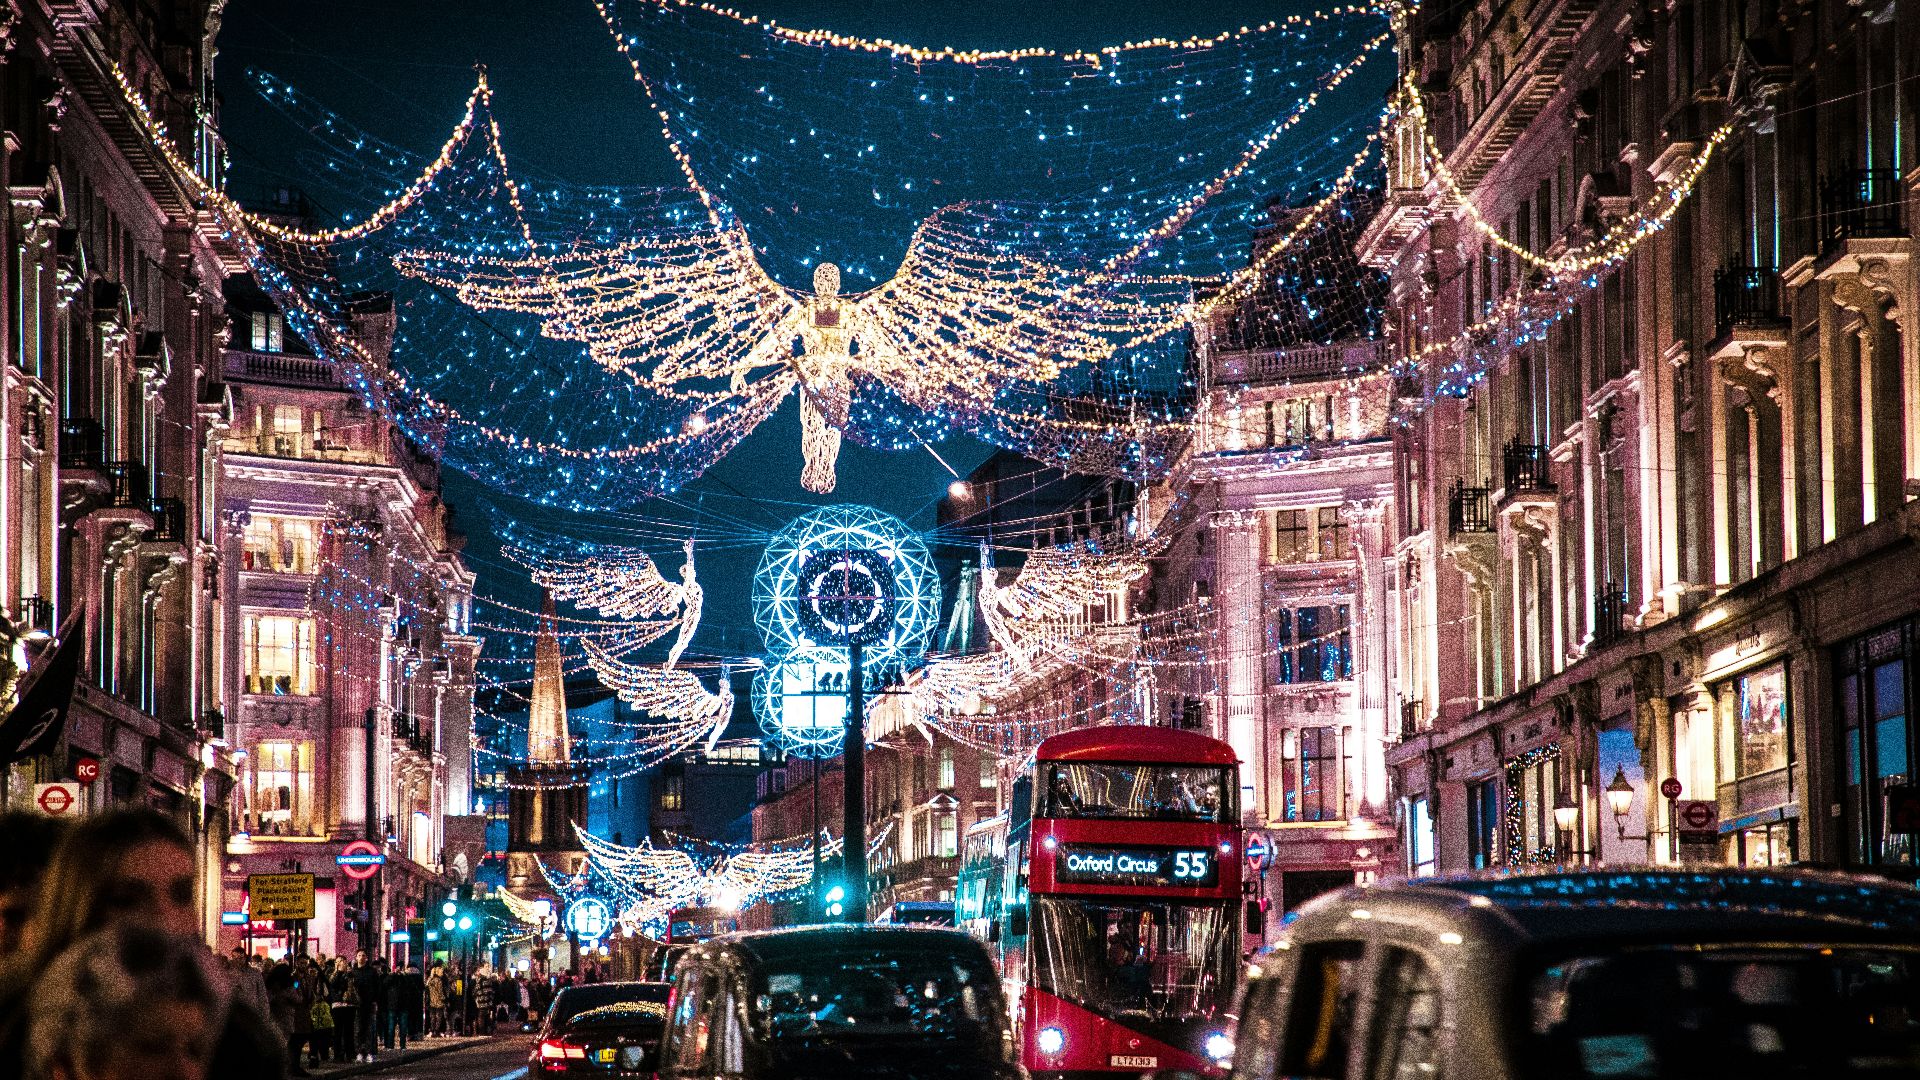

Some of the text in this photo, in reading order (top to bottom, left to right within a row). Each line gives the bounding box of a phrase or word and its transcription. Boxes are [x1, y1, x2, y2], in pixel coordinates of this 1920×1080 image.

[78, 764, 96, 776] RC
[1067, 852, 1207, 878] Oxford Circus 55
